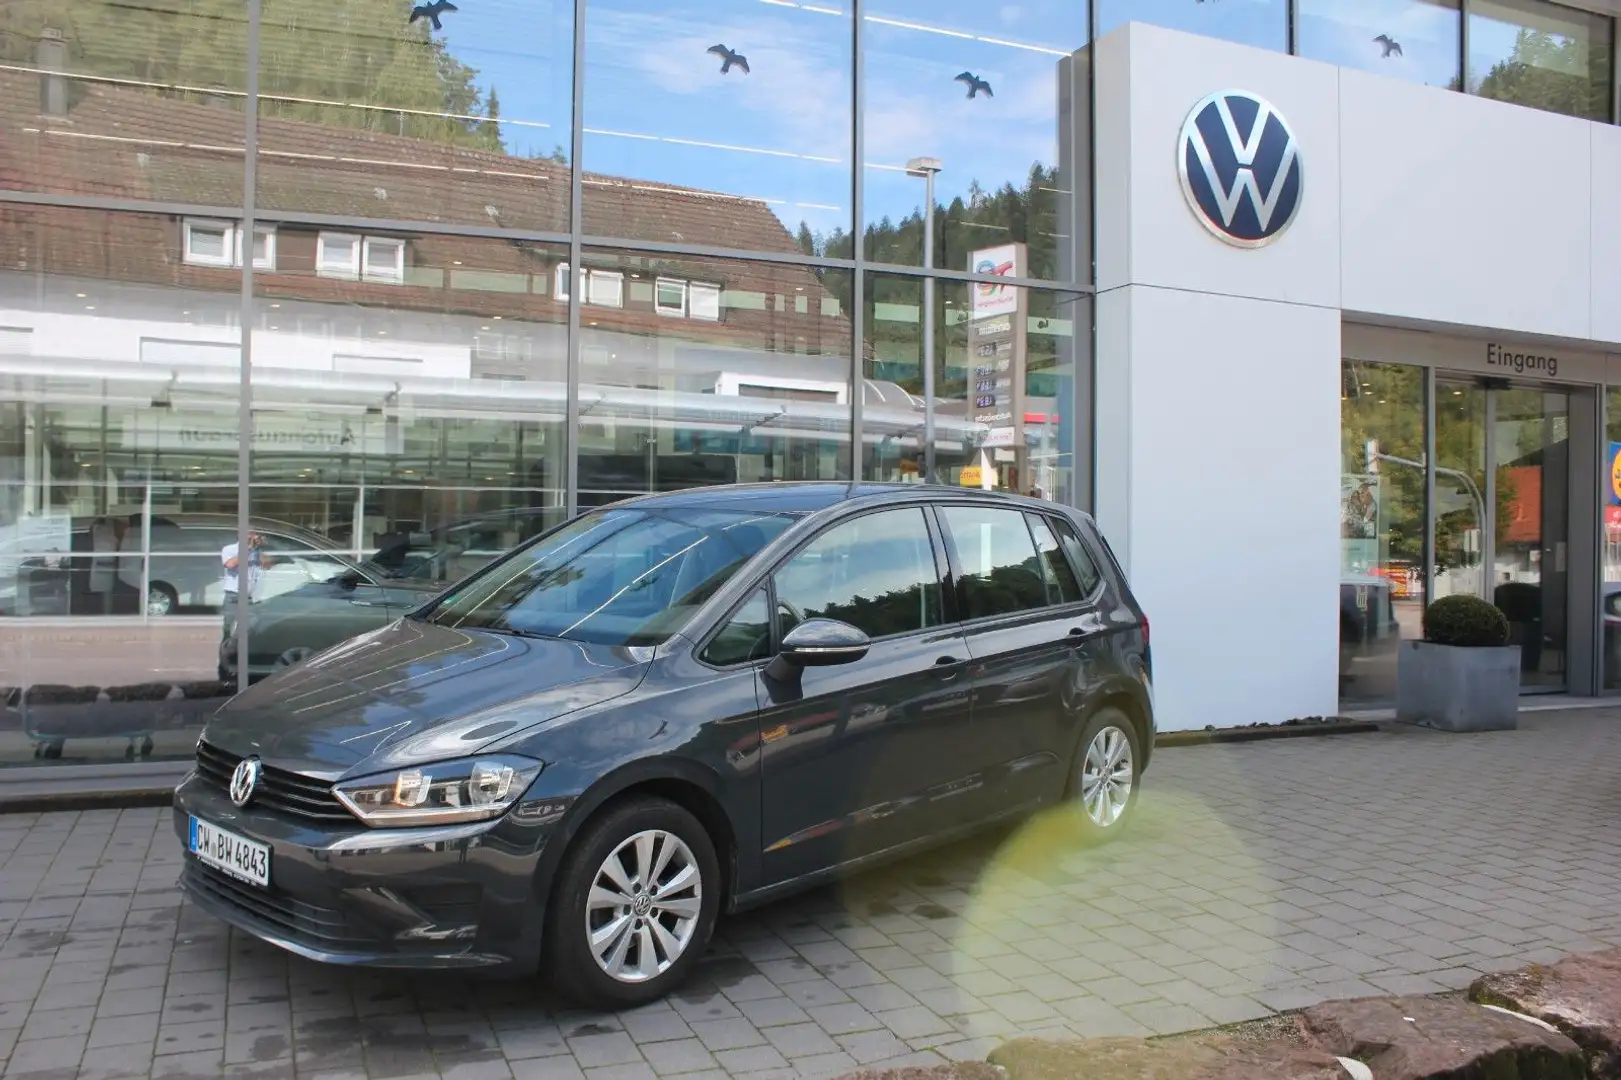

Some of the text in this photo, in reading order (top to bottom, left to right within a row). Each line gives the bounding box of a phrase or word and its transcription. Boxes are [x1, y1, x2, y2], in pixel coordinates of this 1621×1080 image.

[1180, 89, 1302, 248] VW
[1487, 343, 1558, 377] Eingang
[198, 824, 210, 854] CW
[236, 842, 266, 878] 4843
